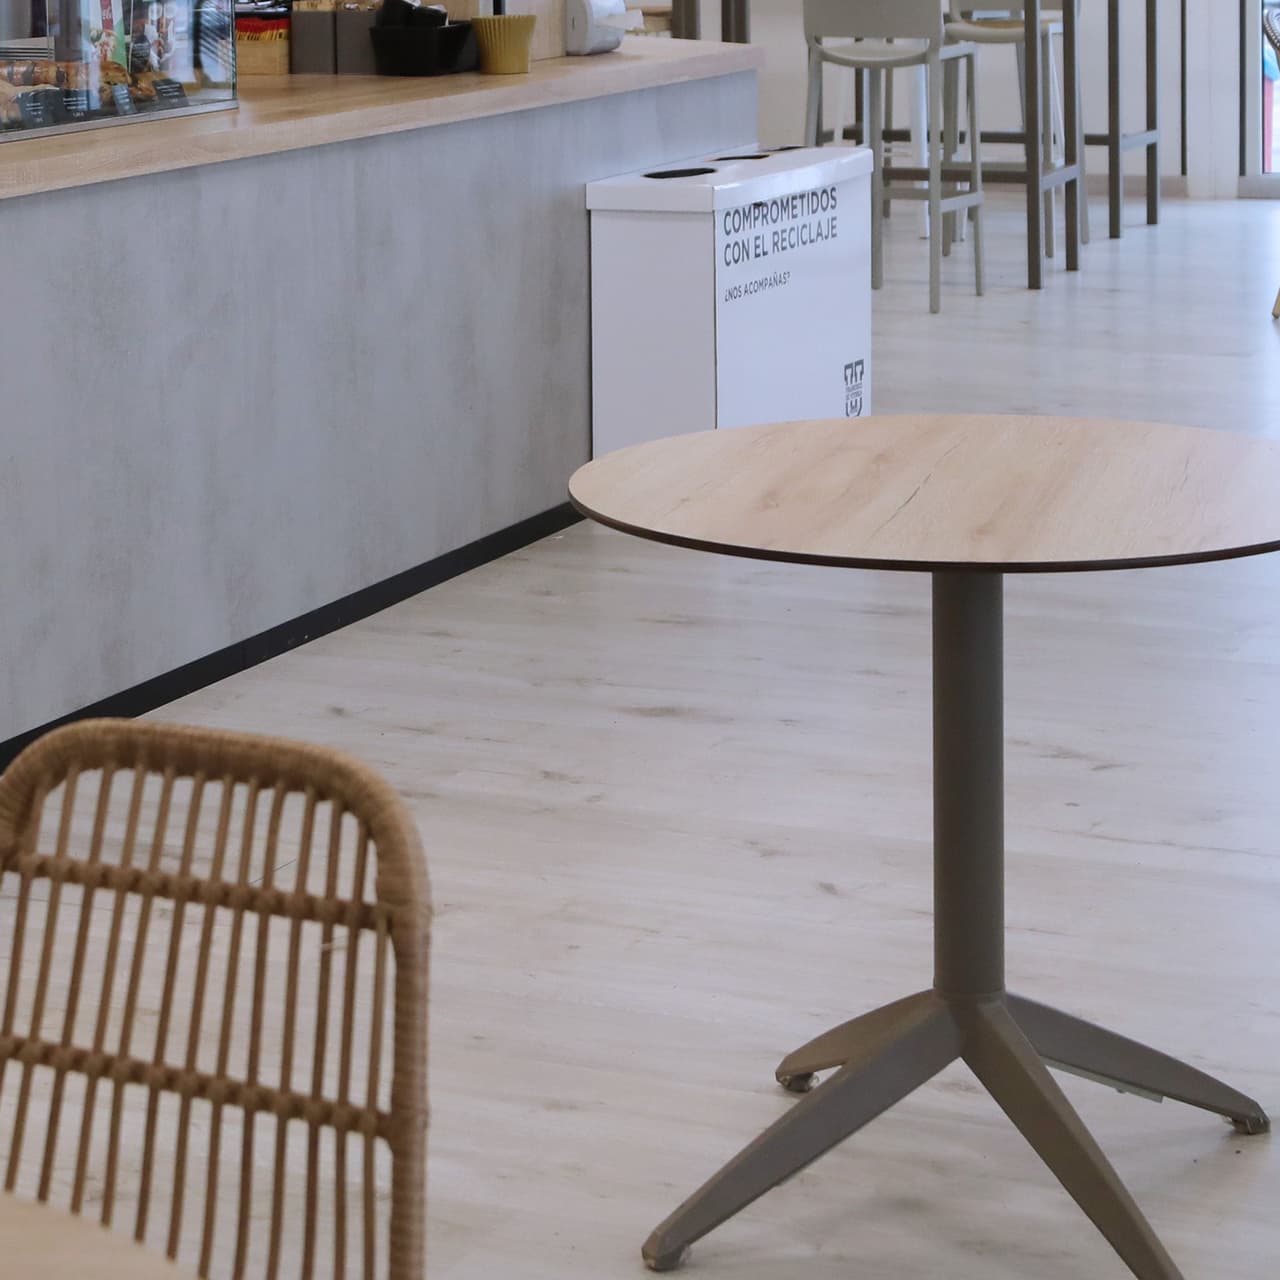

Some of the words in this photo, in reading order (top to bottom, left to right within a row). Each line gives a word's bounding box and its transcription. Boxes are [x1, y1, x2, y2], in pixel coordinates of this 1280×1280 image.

[723, 186, 838, 236] COMPROMETIDOS
[723, 238, 750, 267] CON
[754, 234, 769, 259] EL
[772, 217, 838, 254] RECICLAJE
